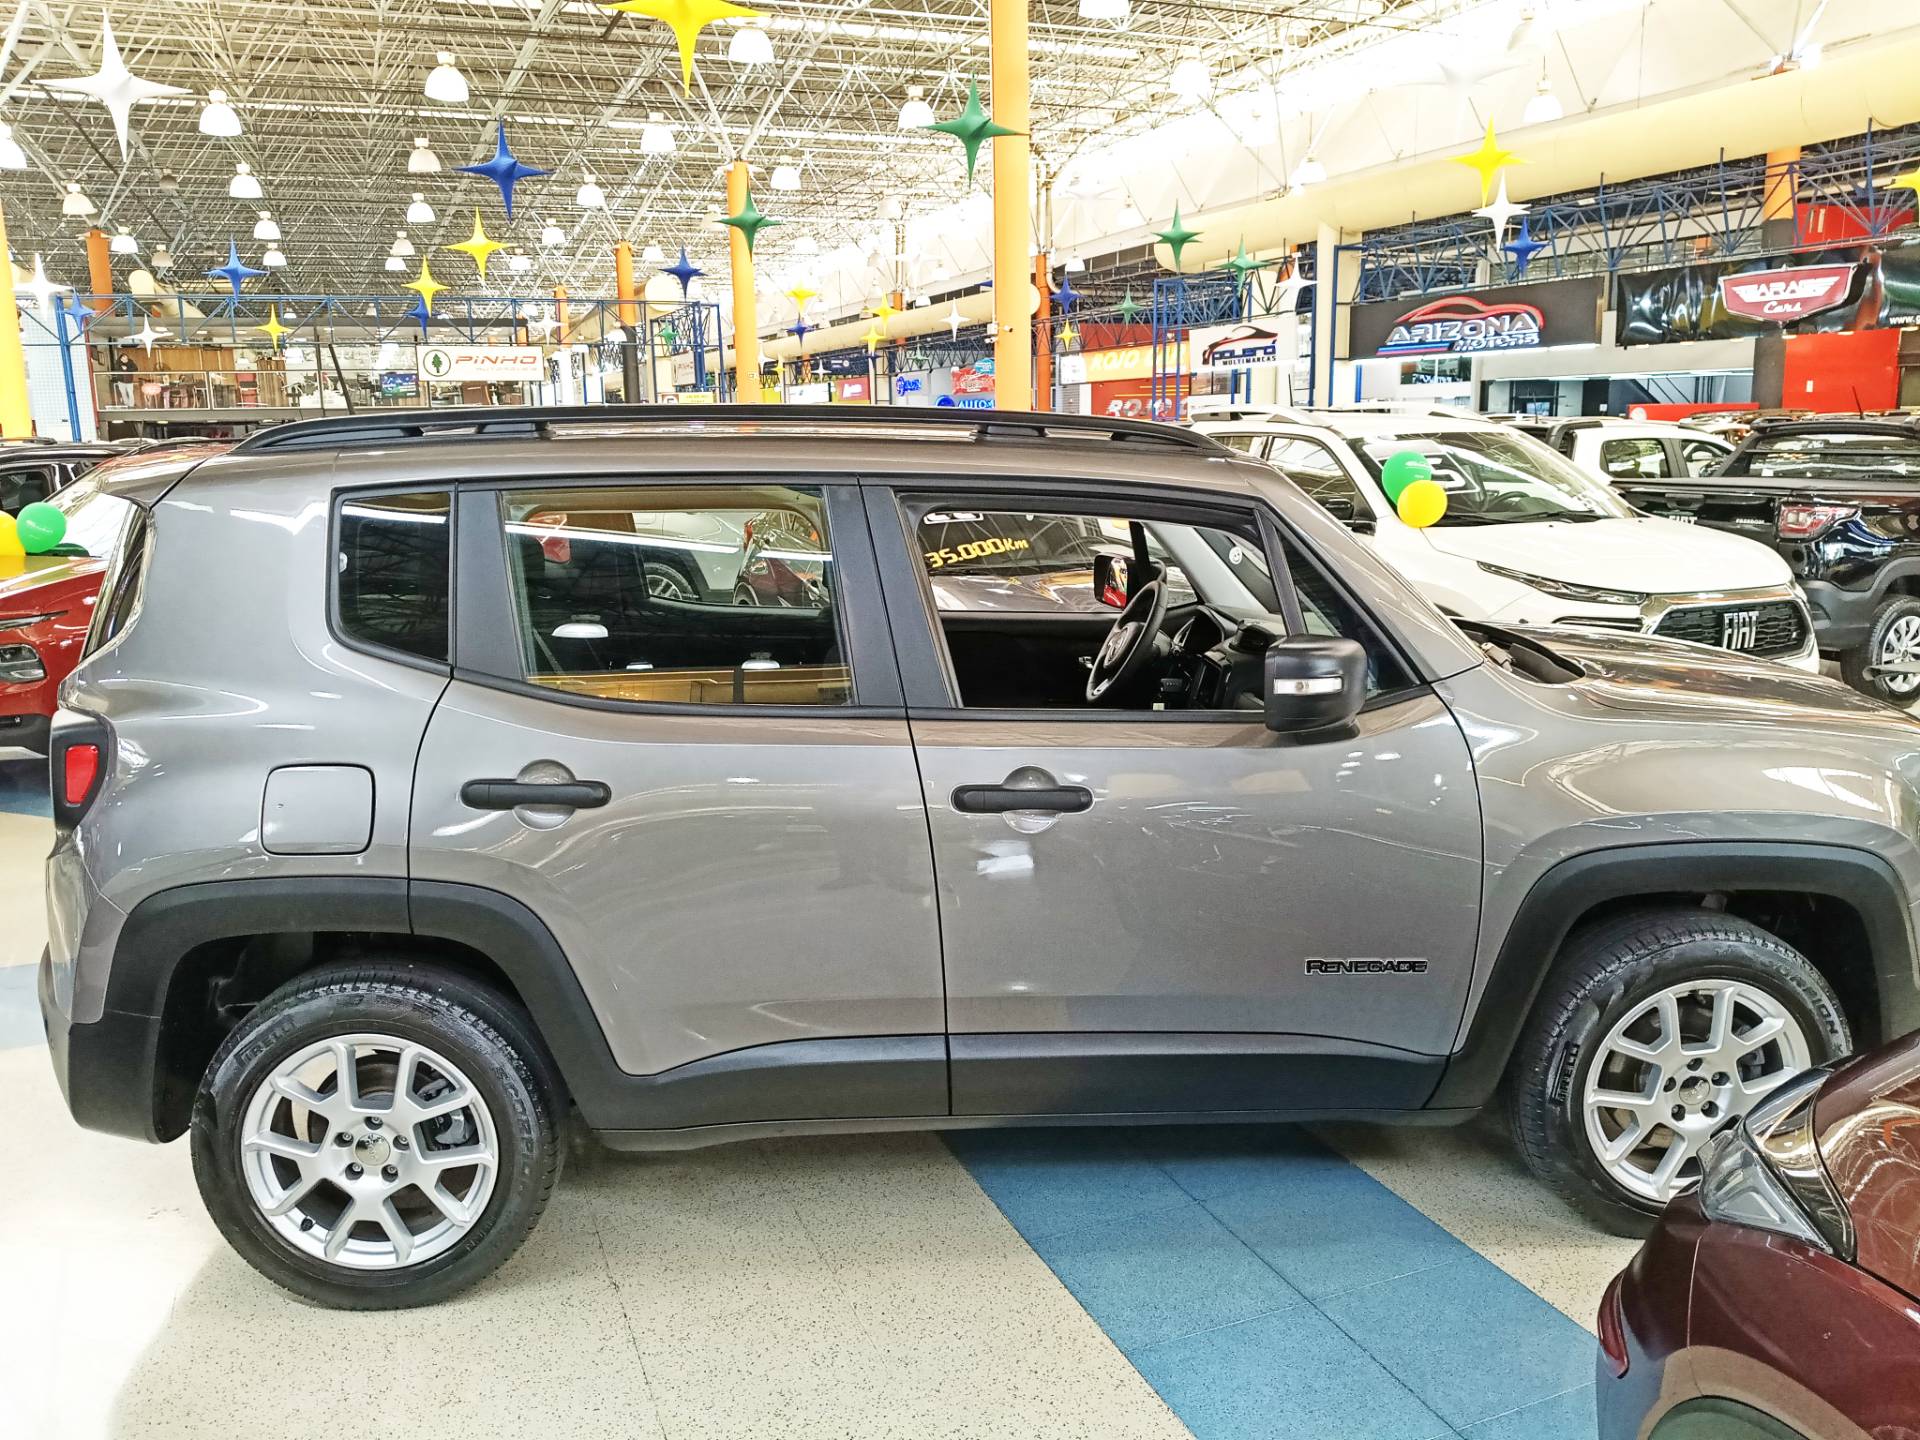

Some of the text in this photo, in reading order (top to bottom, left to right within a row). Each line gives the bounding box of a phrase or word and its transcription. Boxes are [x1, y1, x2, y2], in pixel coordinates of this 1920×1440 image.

[1763, 302, 1802, 324] Cars
[1385, 312, 1539, 346] ARIZONA
[1452, 333, 1540, 351] MOTORS
[925, 538, 1029, 568] 35.000Km
[1722, 610, 1759, 650] FIAT
[1305, 959, 1428, 975] RENEGADE
